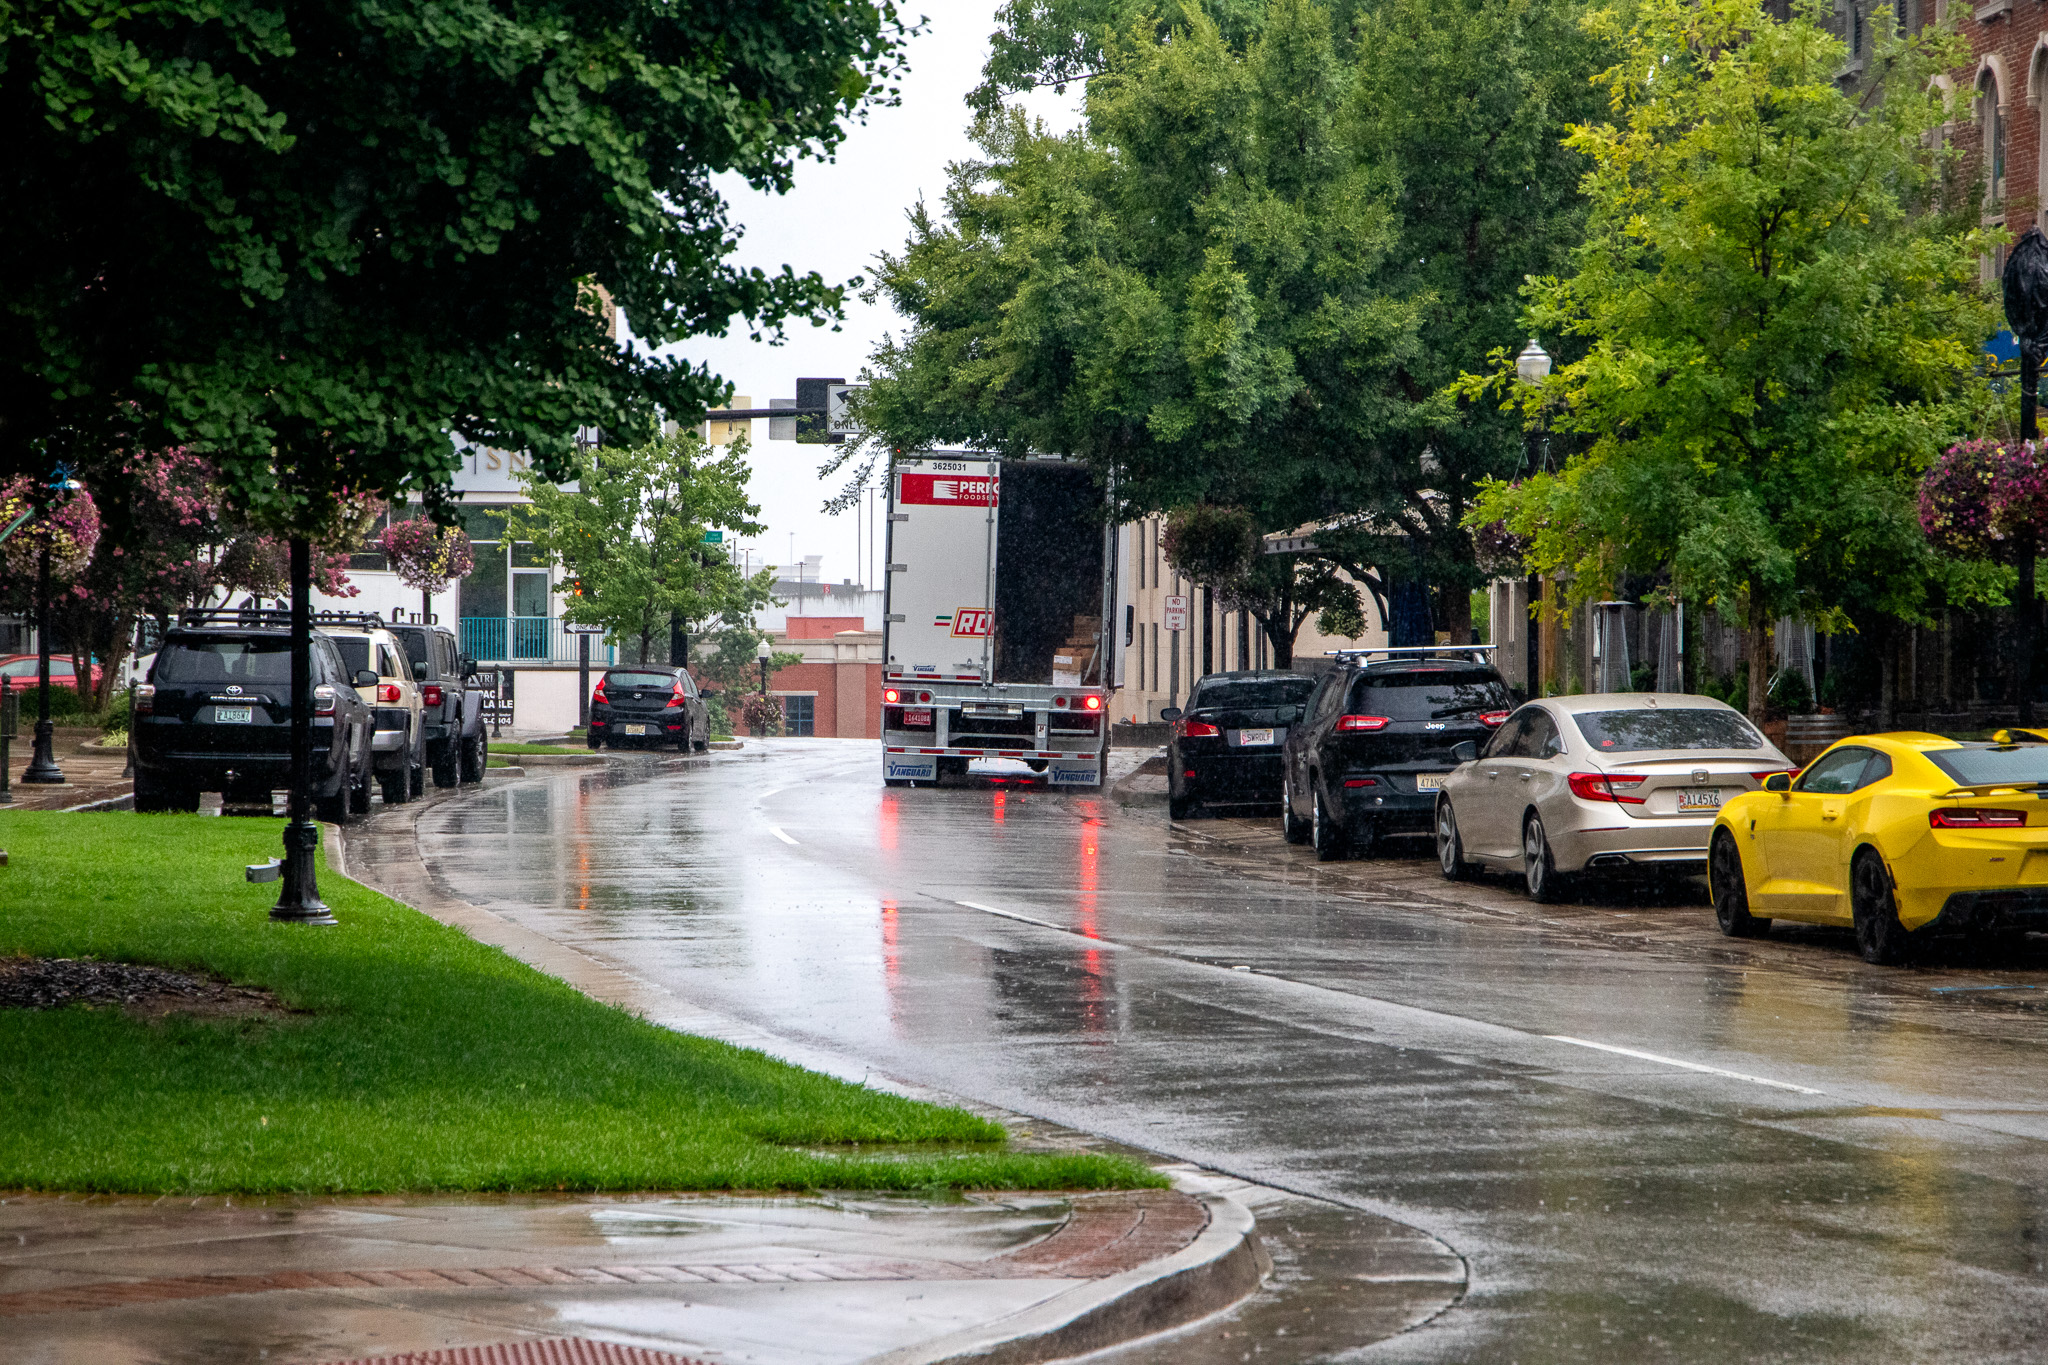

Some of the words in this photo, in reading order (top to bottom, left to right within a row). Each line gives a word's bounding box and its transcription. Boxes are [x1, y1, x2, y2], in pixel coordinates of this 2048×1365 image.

[932, 462, 967, 471] 3625031
[1425, 722, 1446, 730] Jeep
[888, 766, 932, 777] VANGUARD
[1052, 770, 1096, 782] VANGUARD
